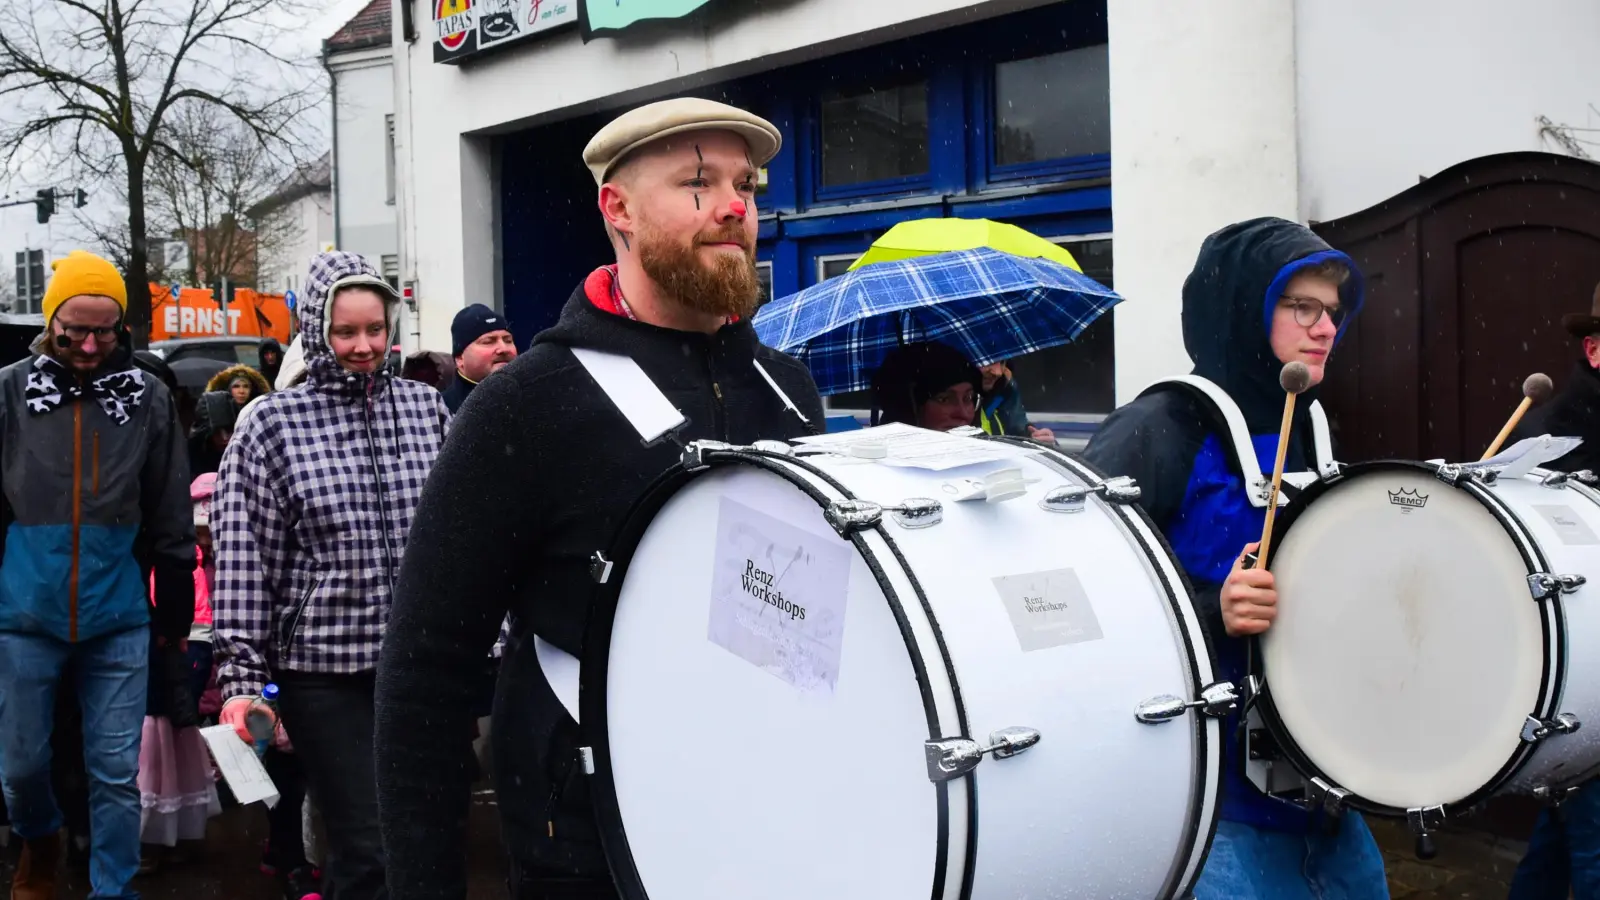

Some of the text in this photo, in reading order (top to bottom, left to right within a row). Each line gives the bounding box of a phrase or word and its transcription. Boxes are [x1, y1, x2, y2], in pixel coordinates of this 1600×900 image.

[436, 10, 473, 37] TAPAS
[164, 306, 241, 334] ERNST
[1393, 496, 1423, 506] REMO
[745, 559, 774, 587] Renz
[741, 574, 806, 621] Workshops
[1023, 596, 1044, 605] Renz
